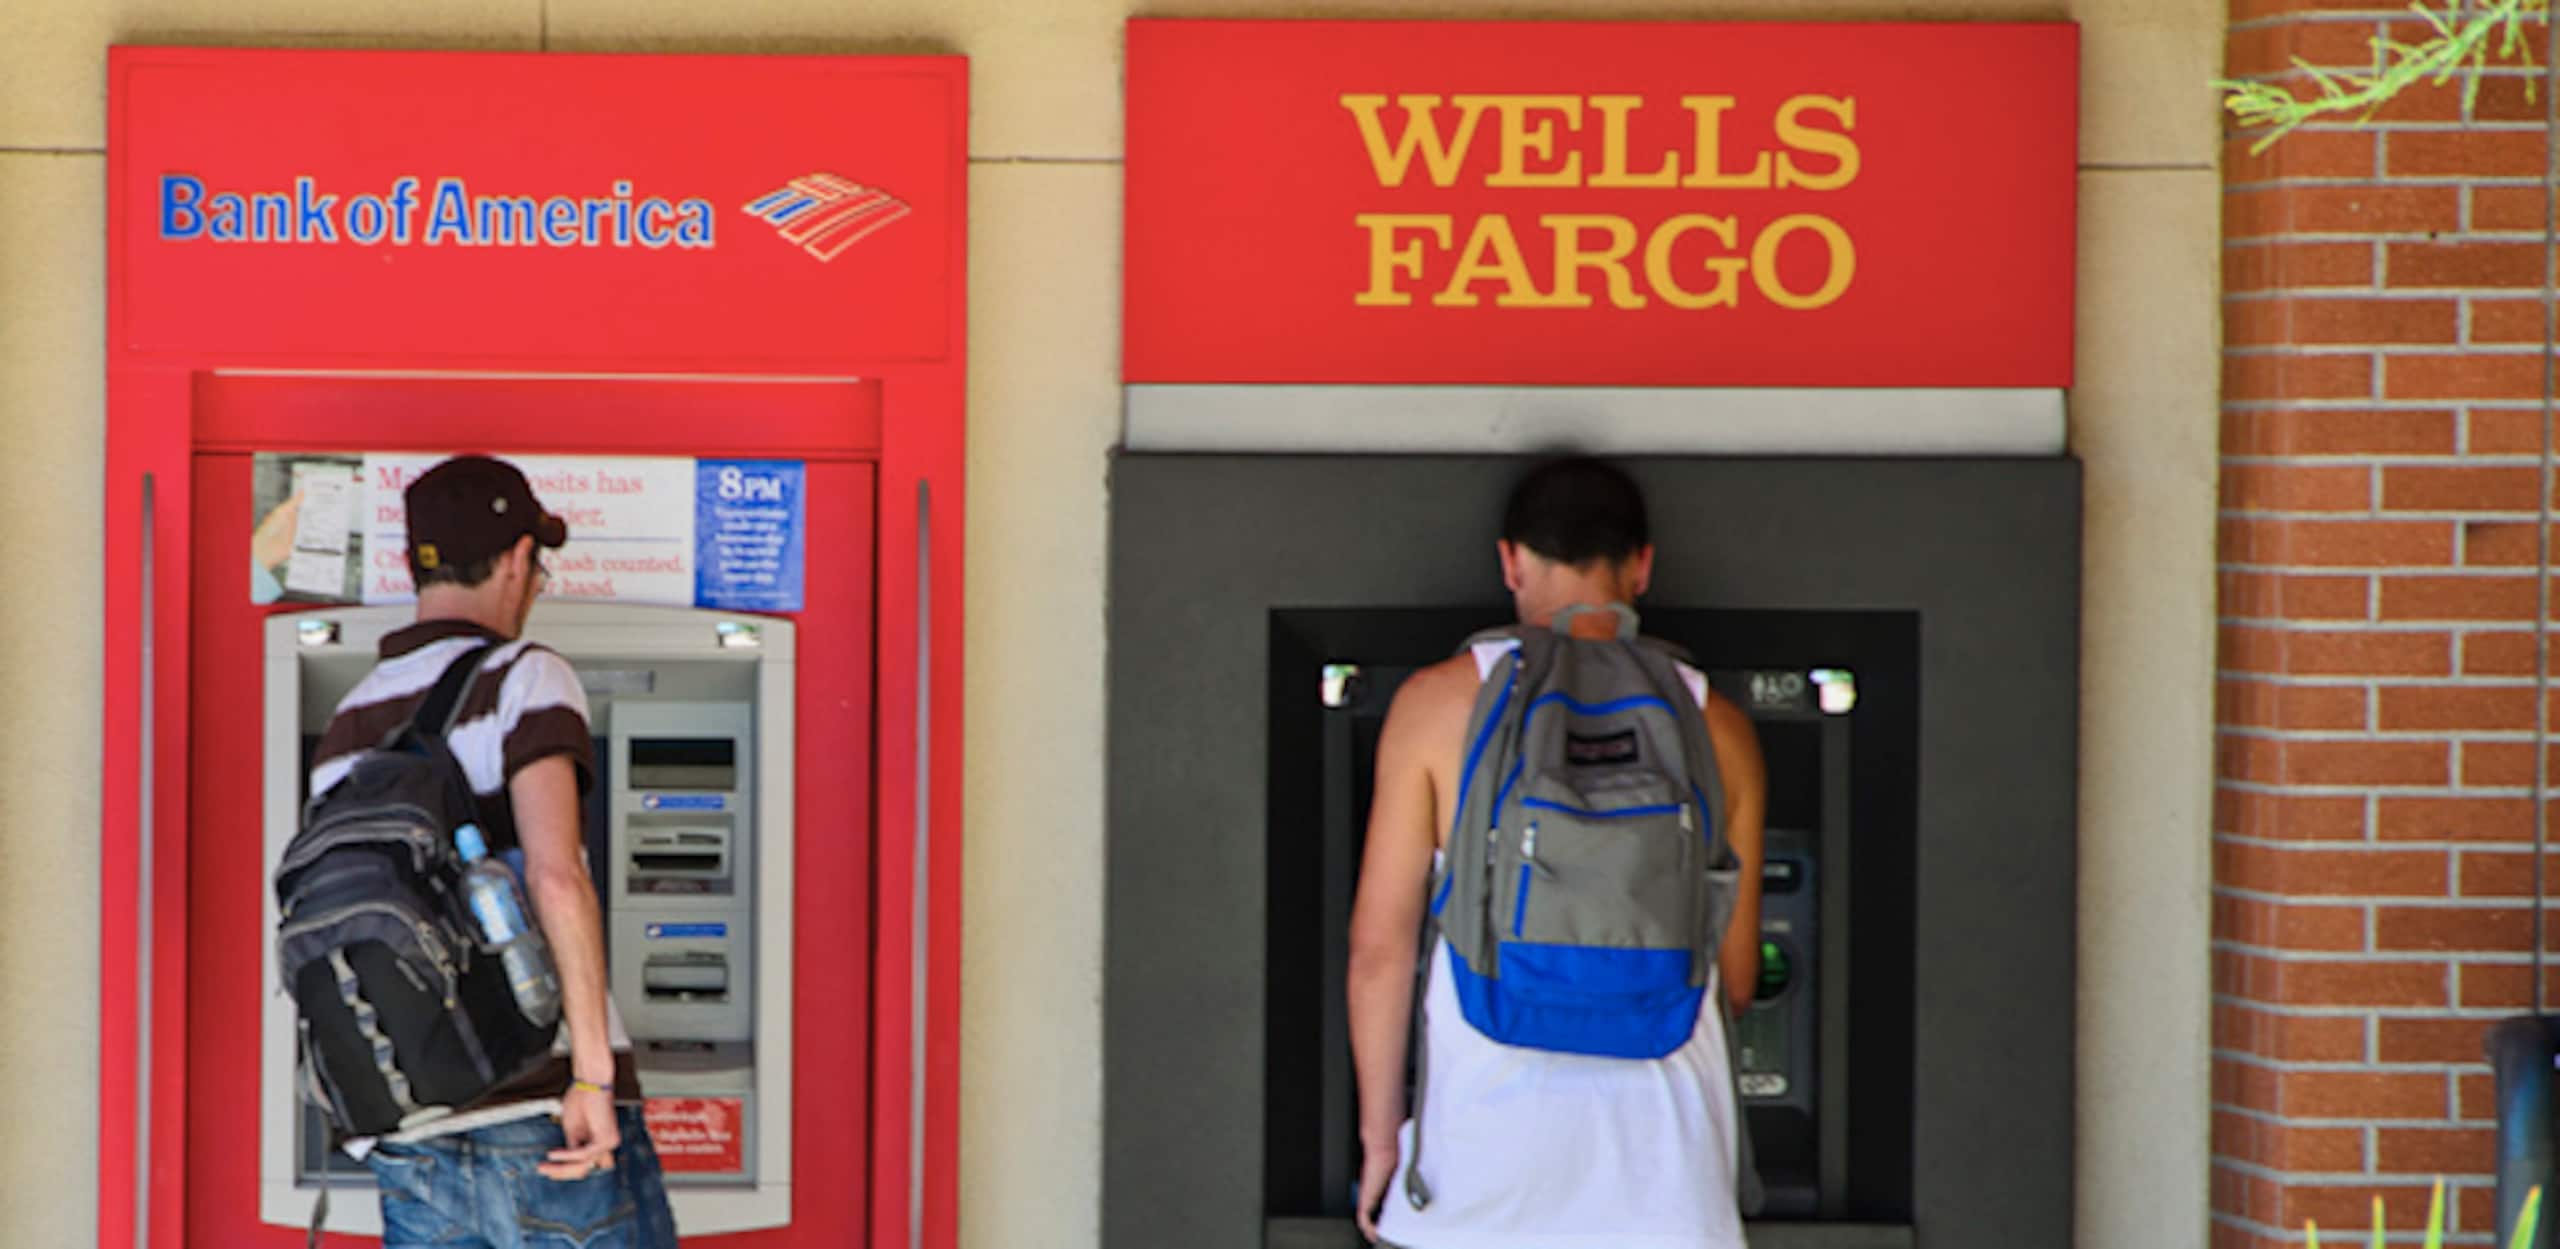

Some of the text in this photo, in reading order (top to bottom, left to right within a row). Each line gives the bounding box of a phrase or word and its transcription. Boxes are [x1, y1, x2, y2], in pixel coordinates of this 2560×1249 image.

[1340, 94, 1861, 190] WELLS
[159, 173, 715, 248] Bank of America
[1354, 213, 1856, 309] FARGO
[528, 469, 643, 494] osits has
